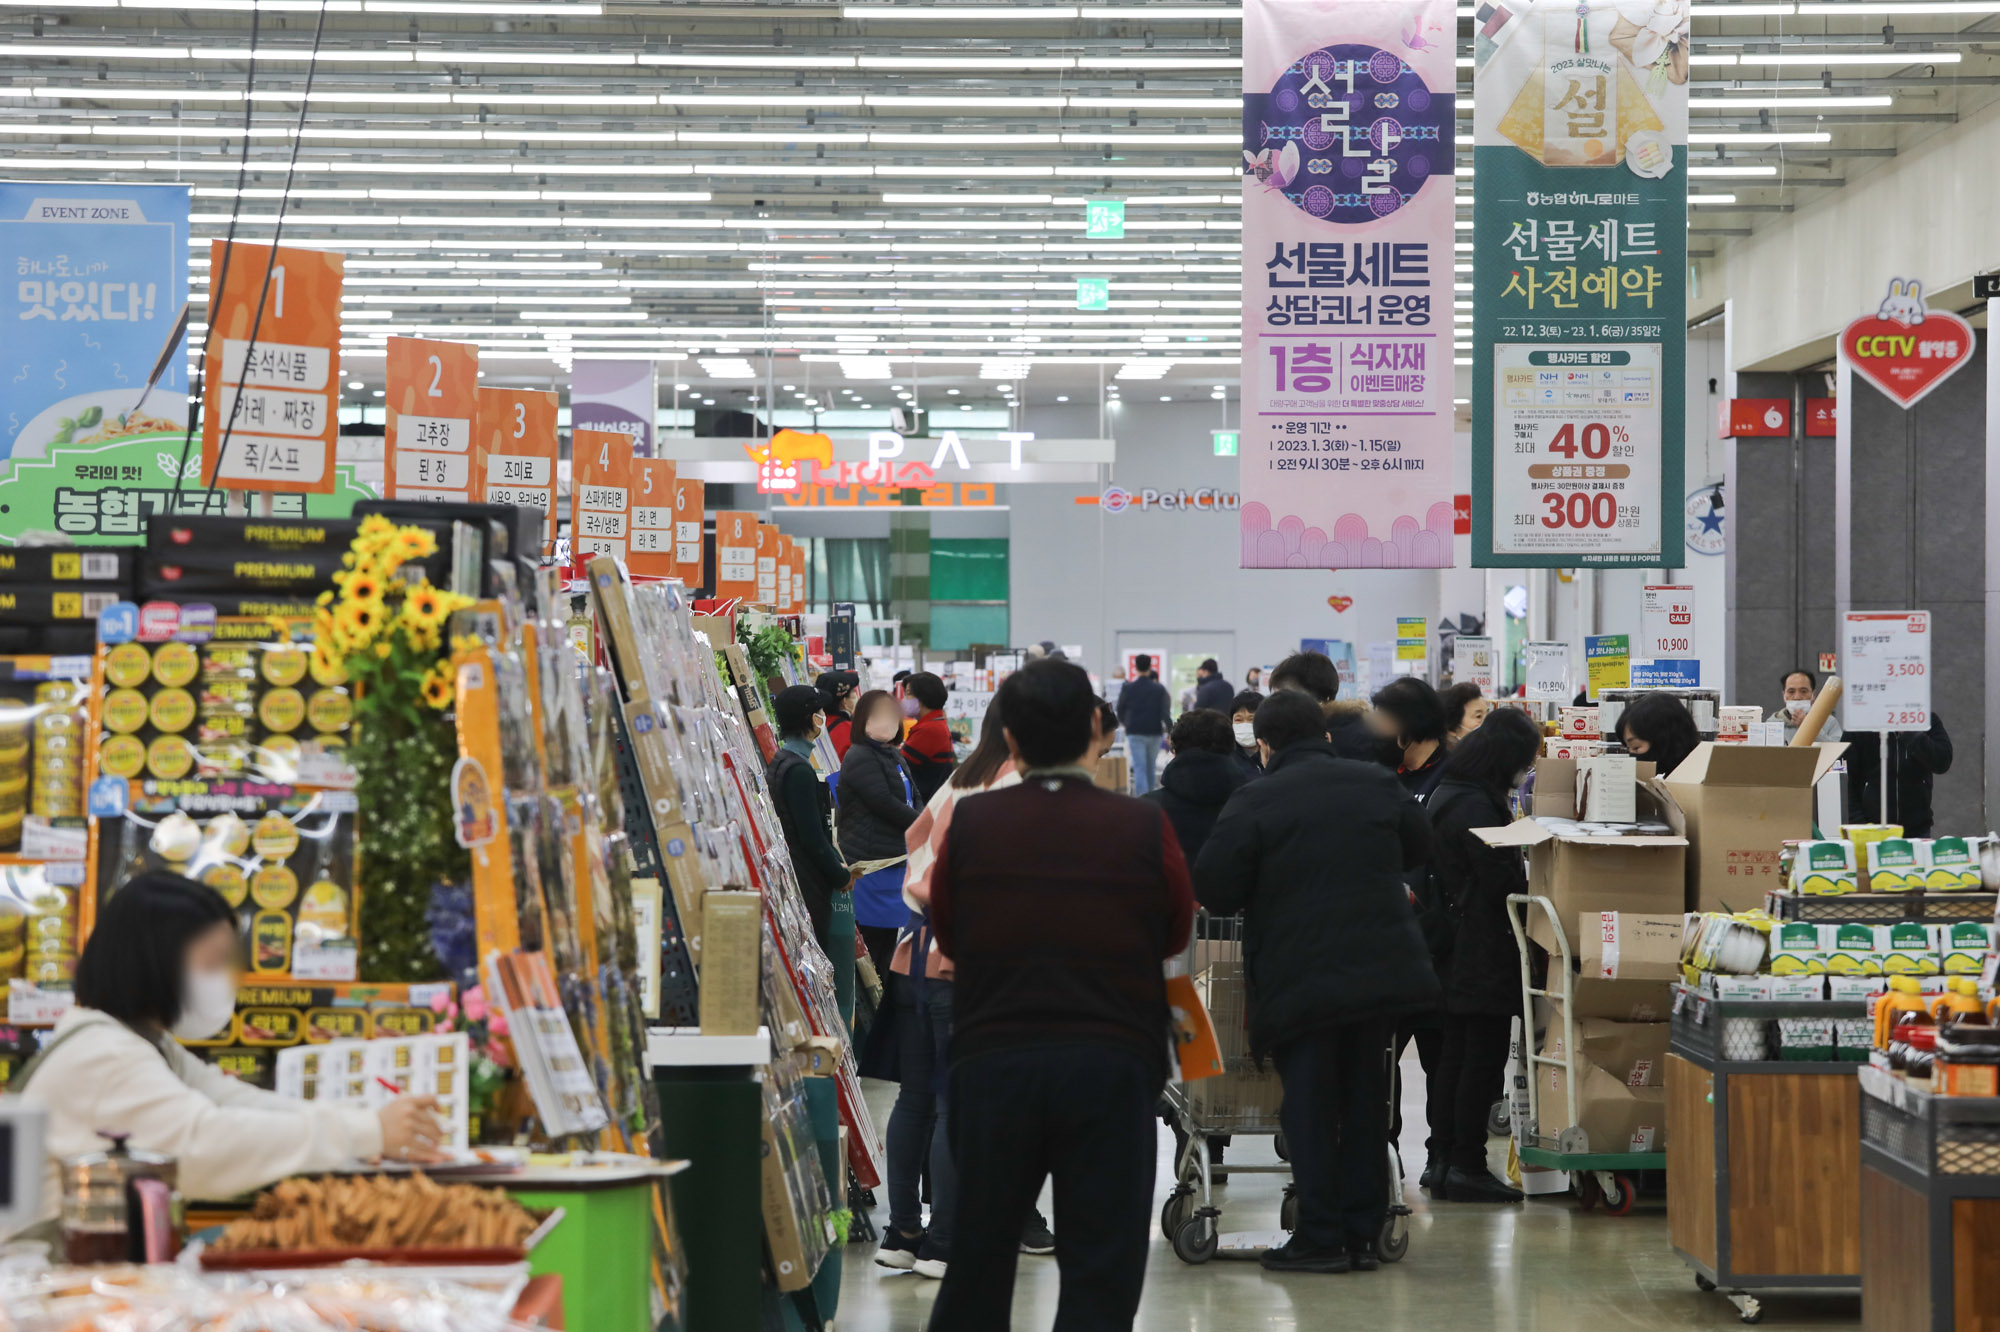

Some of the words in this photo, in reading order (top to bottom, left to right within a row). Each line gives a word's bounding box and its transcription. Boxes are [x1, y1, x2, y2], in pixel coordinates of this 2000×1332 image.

[1551, 59, 1574, 74] 2023
[1576, 58, 1611, 74] 살맛나는
[1553, 75, 1607, 138] 설
[1300, 60, 1400, 194] 설날
[1569, 191, 1640, 205] 하나로마트
[42, 207, 87, 218] EVENT
[91, 208, 129, 218] ZONE
[1502, 218, 1661, 262] 선물세트
[1266, 242, 1430, 288] 선물세트
[271, 265, 285, 318] 1
[1501, 266, 1662, 309] 사전예약
[19, 281, 156, 322] 맛있다!
[1266, 295, 1371, 325] 상담코너
[1378, 295, 1430, 325] 운영
[1631, 325, 1661, 337] 35일간
[1856, 336, 1916, 358] CCTV
[247, 349, 307, 382] 즉석식품
[1350, 343, 1425, 371] 식자재
[1547, 353, 1588, 364] 행사카드
[1590, 353, 1611, 364] 할인
[428, 355, 442, 397] 2
[1269, 343, 1333, 393] 1층
[1351, 375, 1425, 392] 이벤트매장
[1507, 374, 1533, 383] 행사카드
[1270, 400, 1297, 409] 대량구매
[1299, 400, 1325, 409] 고객님을
[1327, 400, 1341, 409] 위한
[1342, 400, 1349, 408] 더
[1351, 400, 1371, 408] 특별한
[1401, 400, 1424, 408] 서비스!
[283, 401, 315, 430] 짜장
[513, 403, 526, 439] 3
[417, 422, 450, 447] 고추장
[1286, 422, 1307, 434] 운영
[1310, 422, 1331, 434] 기간
[1514, 423, 1539, 431] 행사카드
[599, 443, 609, 471] 4
[1514, 442, 1535, 454] 최대
[244, 444, 299, 473] 죽/스프
[1277, 460, 1297, 470] 오전
[1299, 458, 1318, 470] 9시
[1321, 458, 1350, 470] 30분
[1361, 460, 1380, 470] 오후
[75, 465, 118, 480] 우리의
[122, 465, 142, 480] 맛!
[504, 460, 533, 480] 조미료
[811, 461, 937, 488] 다이소
[1552, 466, 1582, 477] 상품권
[644, 468, 653, 494] 5
[1531, 482, 1555, 490] 행사카드
[1557, 482, 1590, 490] 30만원이상
[586, 489, 622, 508] 스파게티면
[676, 487, 685, 511] 6
[1141, 488, 1188, 512] Pet
[1514, 514, 1535, 525] 최대
[1541, 492, 1617, 529] 300
[245, 525, 325, 542] PREMIUM
[587, 516, 619, 534] 국수/냉면
[734, 519, 742, 538] 8
[234, 561, 314, 579] PREMIUM
[1657, 638, 1688, 651] 10,900
[1887, 664, 1924, 677] 3,500
[1538, 681, 1565, 693] 10,800
[1887, 712, 1925, 725] 2,850
